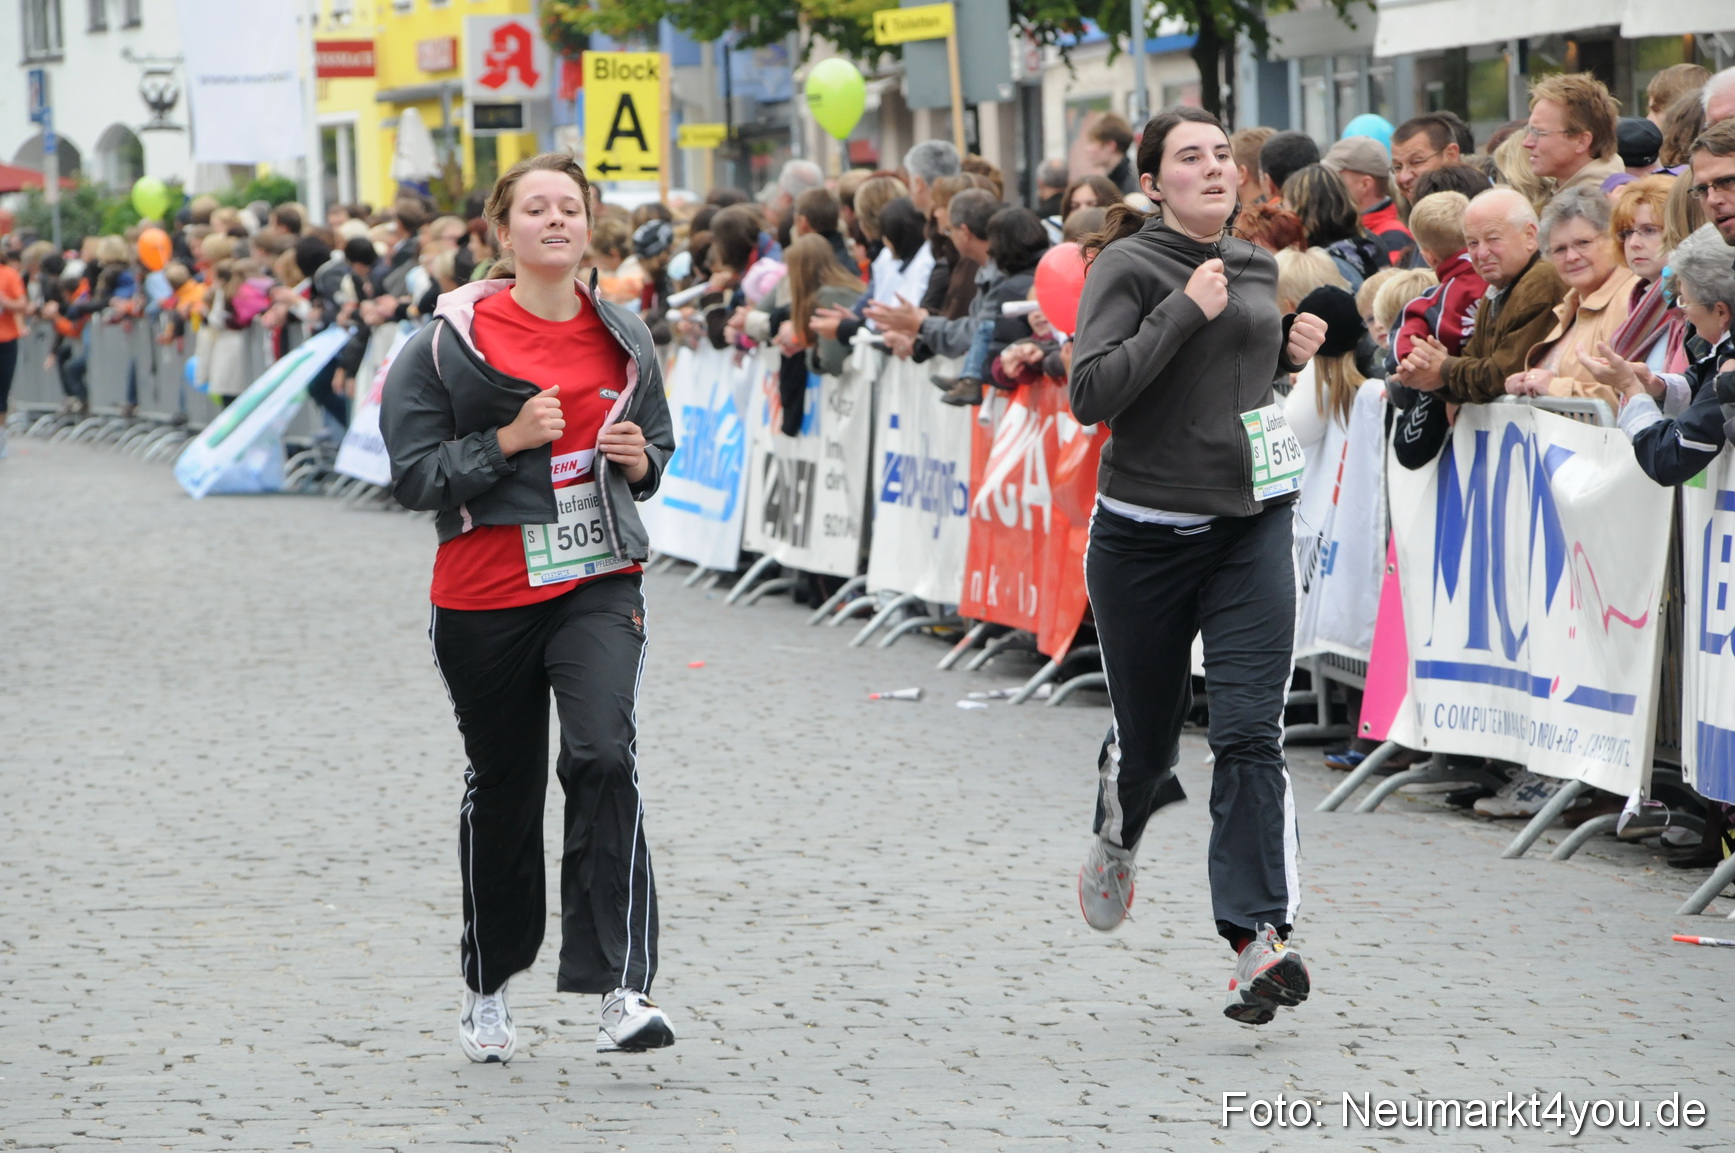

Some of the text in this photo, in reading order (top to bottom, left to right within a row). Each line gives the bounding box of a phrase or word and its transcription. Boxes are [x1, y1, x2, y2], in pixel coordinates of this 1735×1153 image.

[594, 58, 660, 80] Block
[604, 93, 649, 151] A
[1254, 446, 1260, 459] S
[1272, 436, 1301, 466] 5196
[551, 459, 578, 475] EHN
[558, 493, 600, 514] tefanie
[527, 531, 536, 544] S
